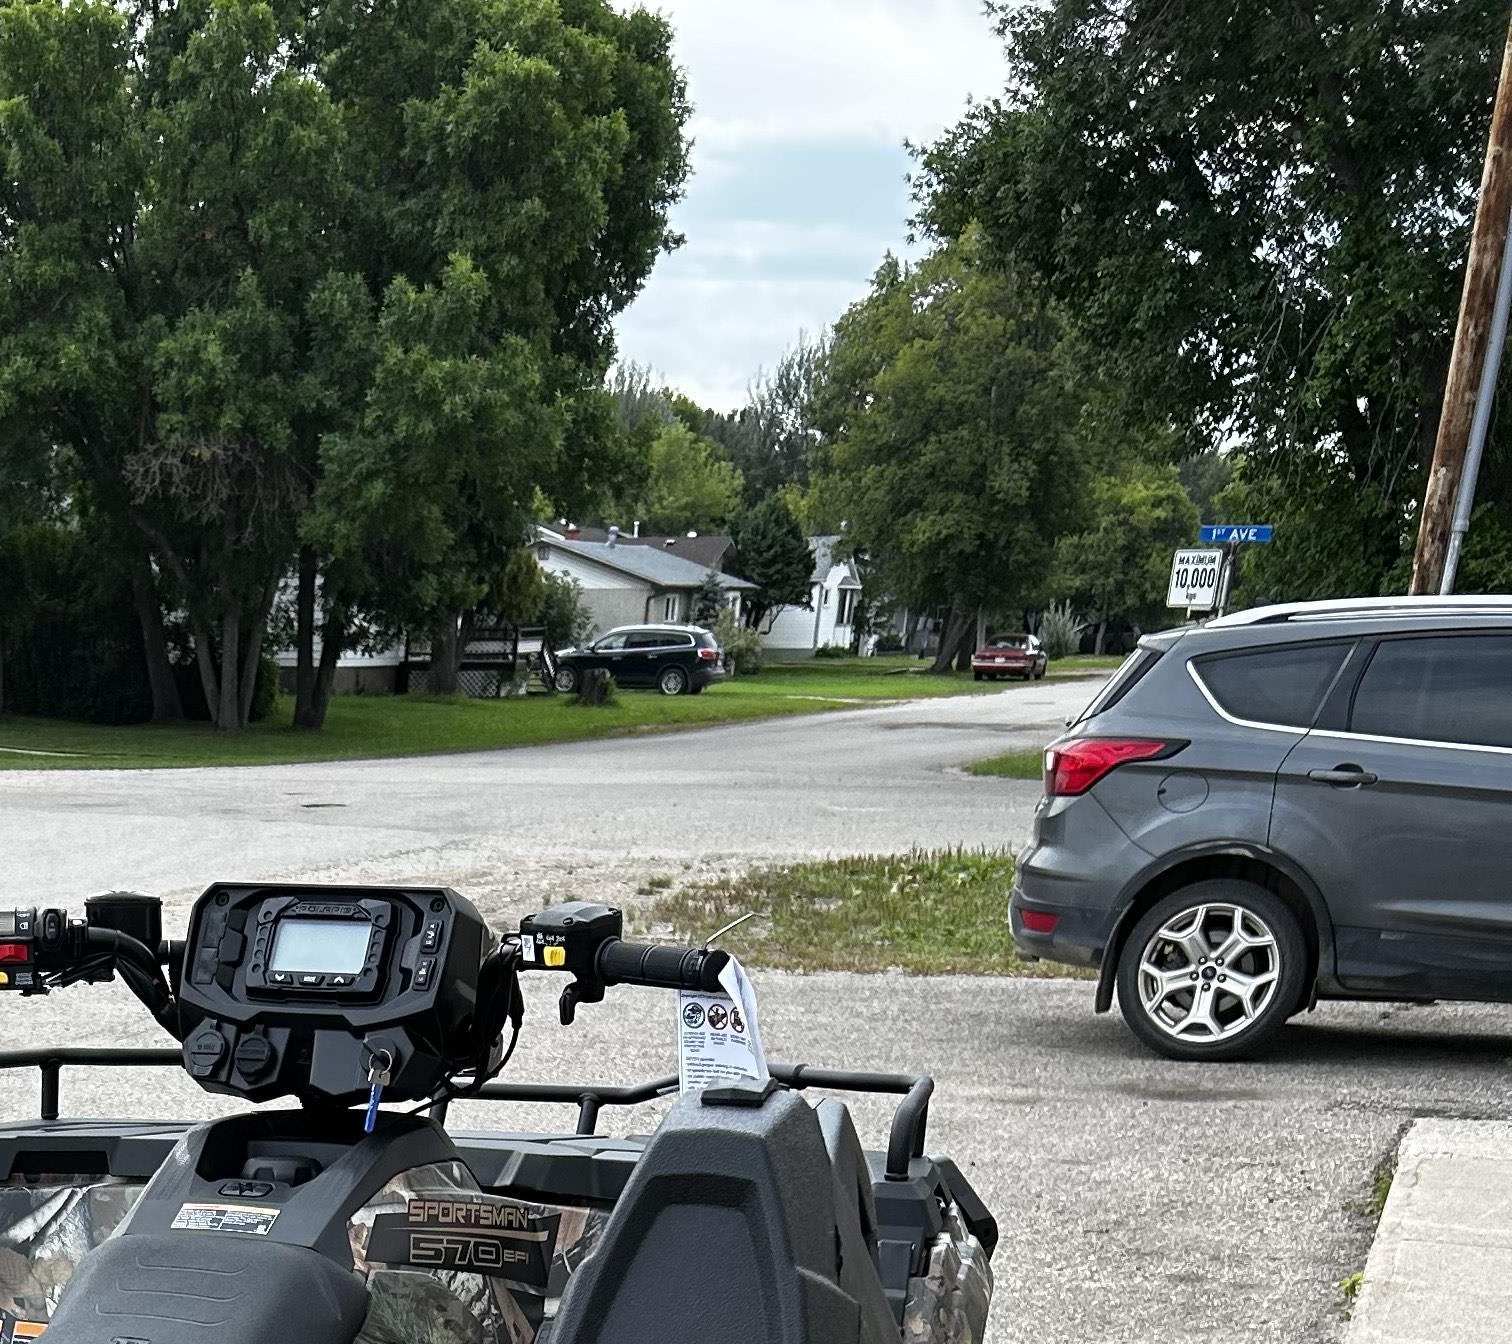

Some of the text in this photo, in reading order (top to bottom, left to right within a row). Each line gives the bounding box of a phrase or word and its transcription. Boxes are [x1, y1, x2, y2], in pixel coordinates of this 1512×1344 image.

[1229, 528, 1258, 541] AVE
[1178, 554, 1216, 566] MAXIMUM
[1175, 567, 1216, 590] 10,000
[408, 1201, 529, 1230] SPORTSMAN
[409, 1233, 530, 1268] 570 EFI
